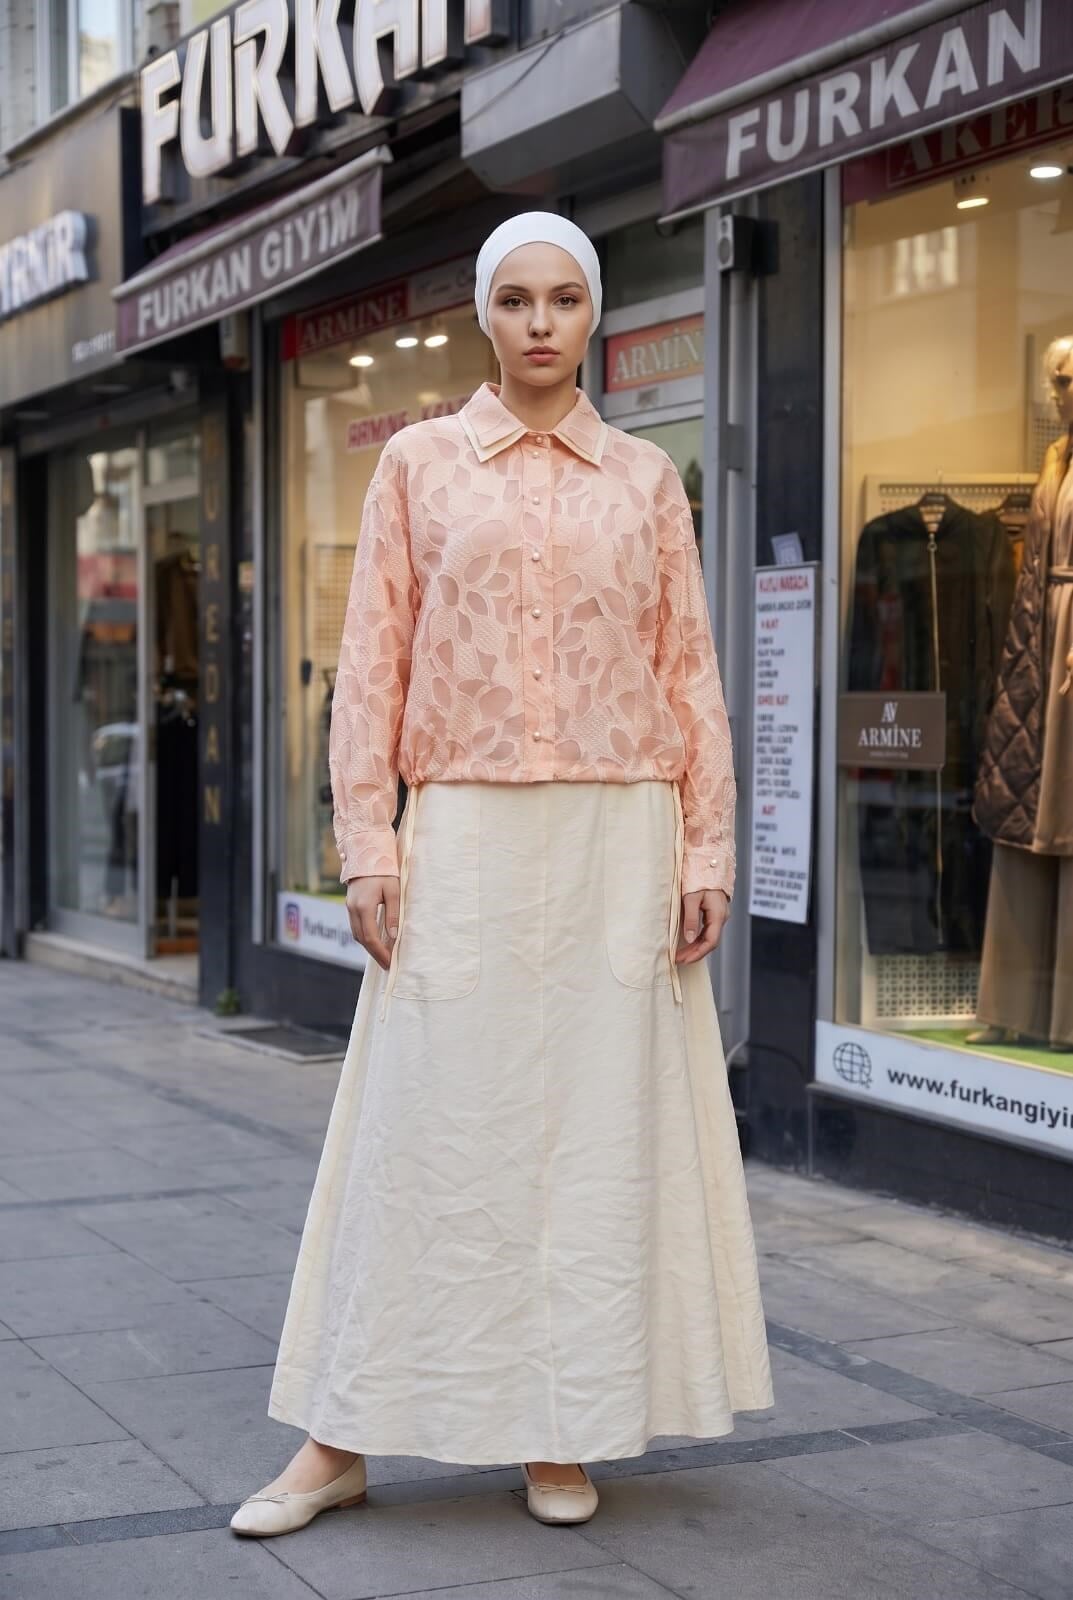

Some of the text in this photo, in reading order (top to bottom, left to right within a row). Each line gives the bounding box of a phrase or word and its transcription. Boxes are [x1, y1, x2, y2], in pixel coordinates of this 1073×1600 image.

[725, 0, 1042, 181] FURKAN
[137, 187, 360, 339] FURKAN GİYİM
[858, 723, 922, 749] ARMİNE
[887, 1068, 1073, 1129] www.furkangiyi
